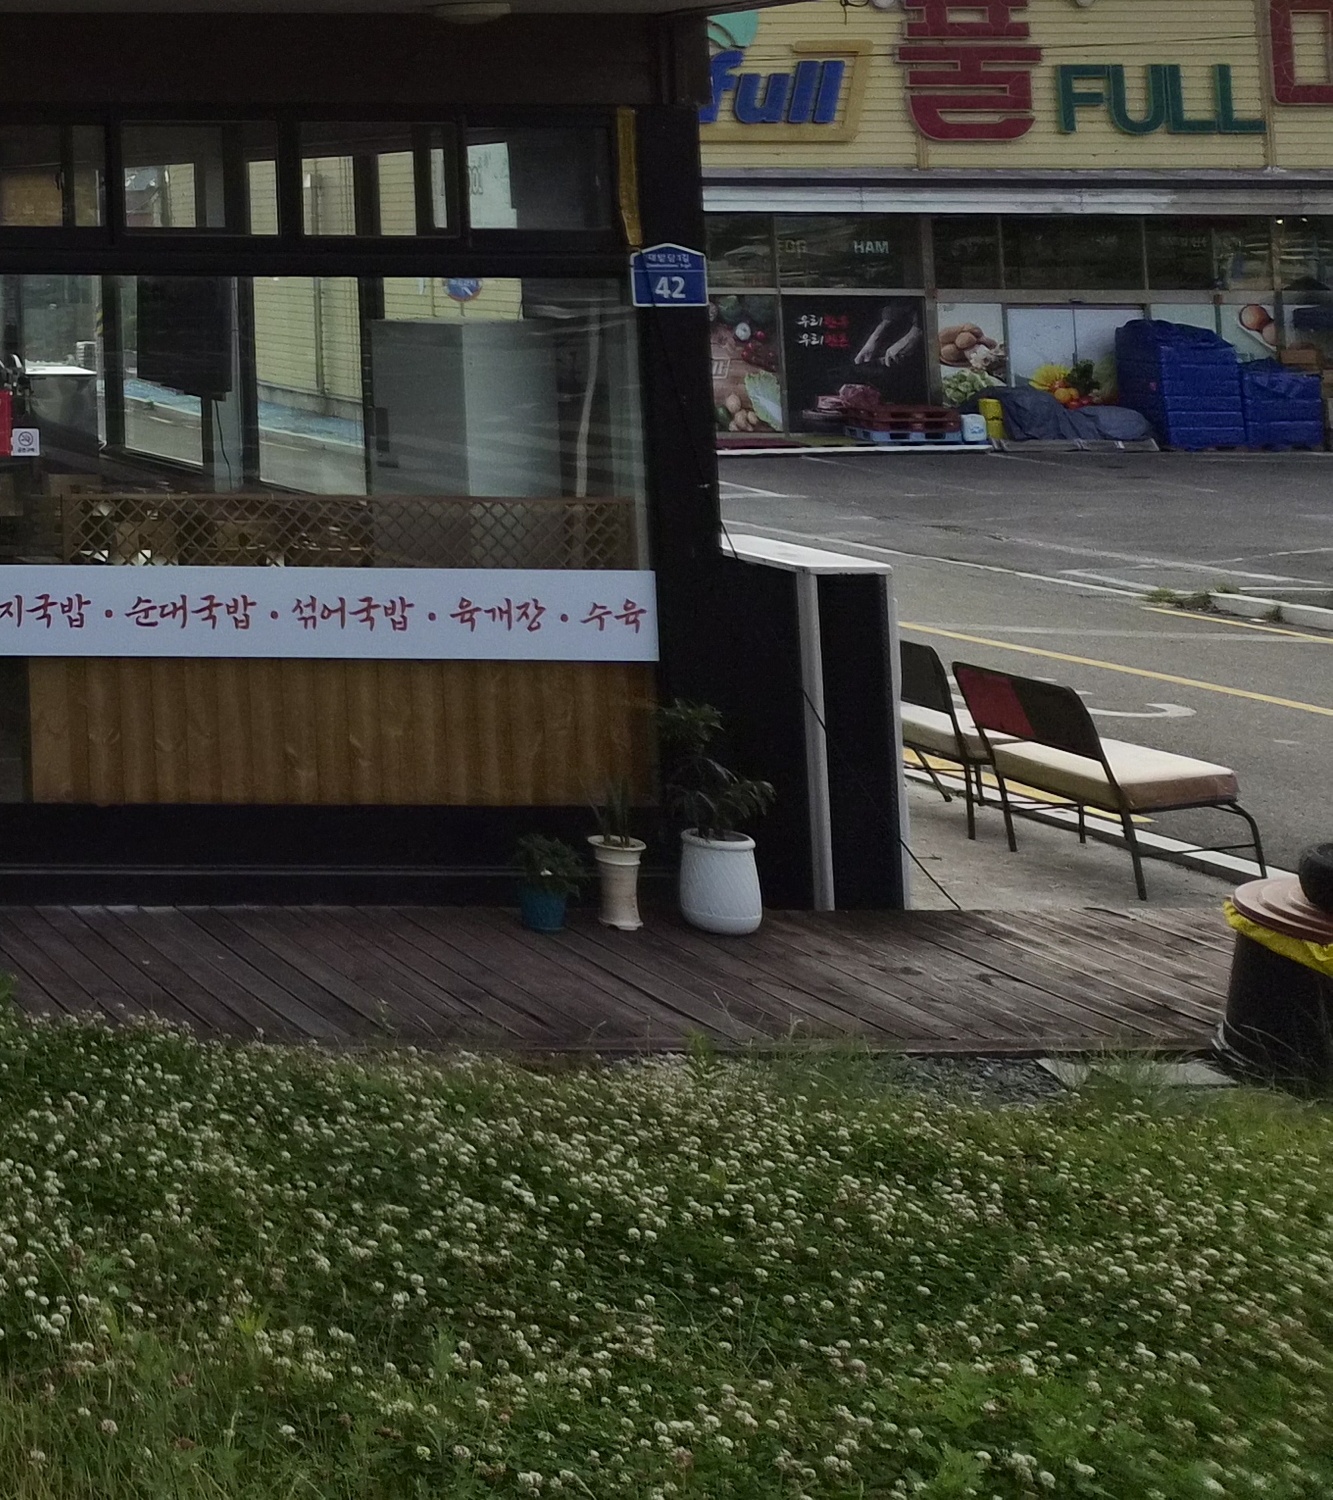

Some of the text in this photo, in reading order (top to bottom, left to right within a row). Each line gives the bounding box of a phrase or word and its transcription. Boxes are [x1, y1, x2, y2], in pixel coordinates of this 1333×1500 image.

[700, 51, 845, 123] full
[1056, 64, 1266, 135] FULL
[854, 240, 889, 254] HAM
[655, 276, 686, 299] 42
[125, 595, 257, 629] 순대국밥
[292, 595, 414, 631] 섞어국밥
[450, 597, 545, 632] 육개장
[580, 599, 644, 633] 수육
